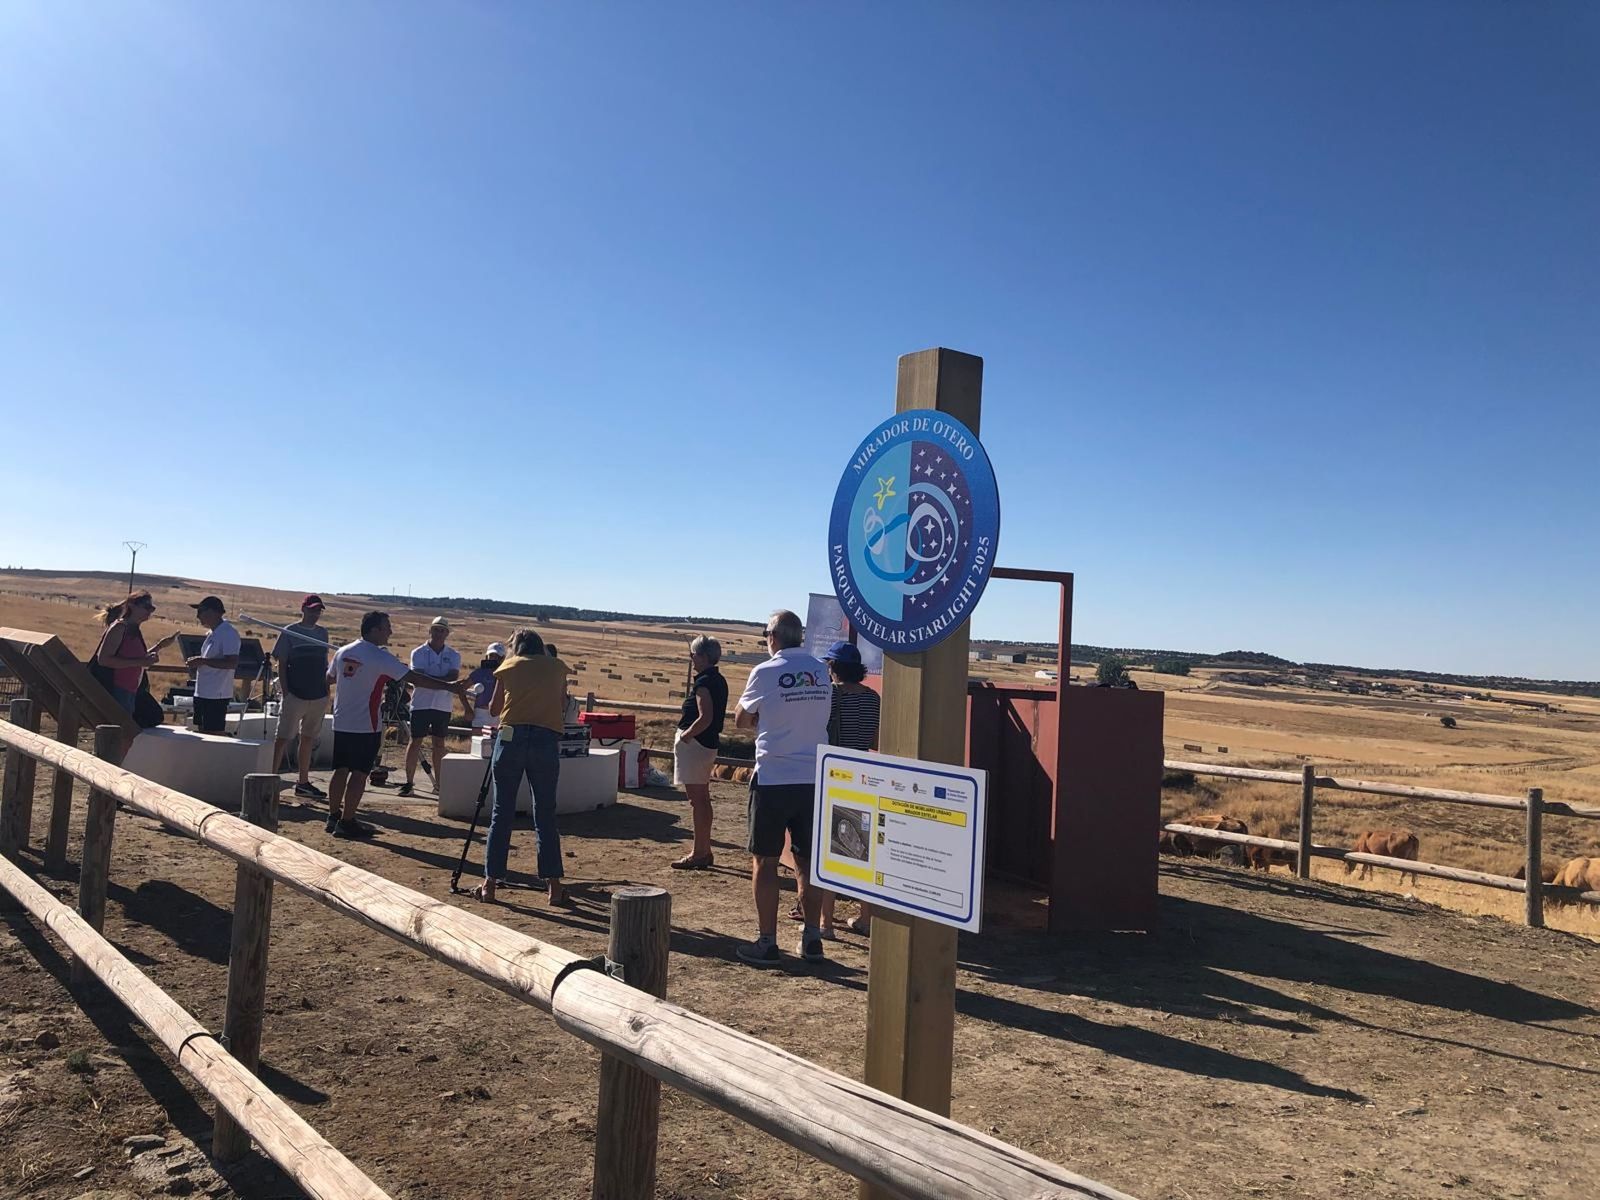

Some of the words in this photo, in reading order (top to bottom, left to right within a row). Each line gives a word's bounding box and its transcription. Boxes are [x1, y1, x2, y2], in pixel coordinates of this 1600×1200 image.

[852, 420, 909, 475] MIRADOR
[913, 418, 930, 432] DE
[933, 420, 974, 461] OTERO
[833, 544, 857, 609] PARQUE
[854, 606, 907, 644] ESTELAR
[909, 575, 977, 644] STARLIGHT
[972, 536, 990, 575] 2025
